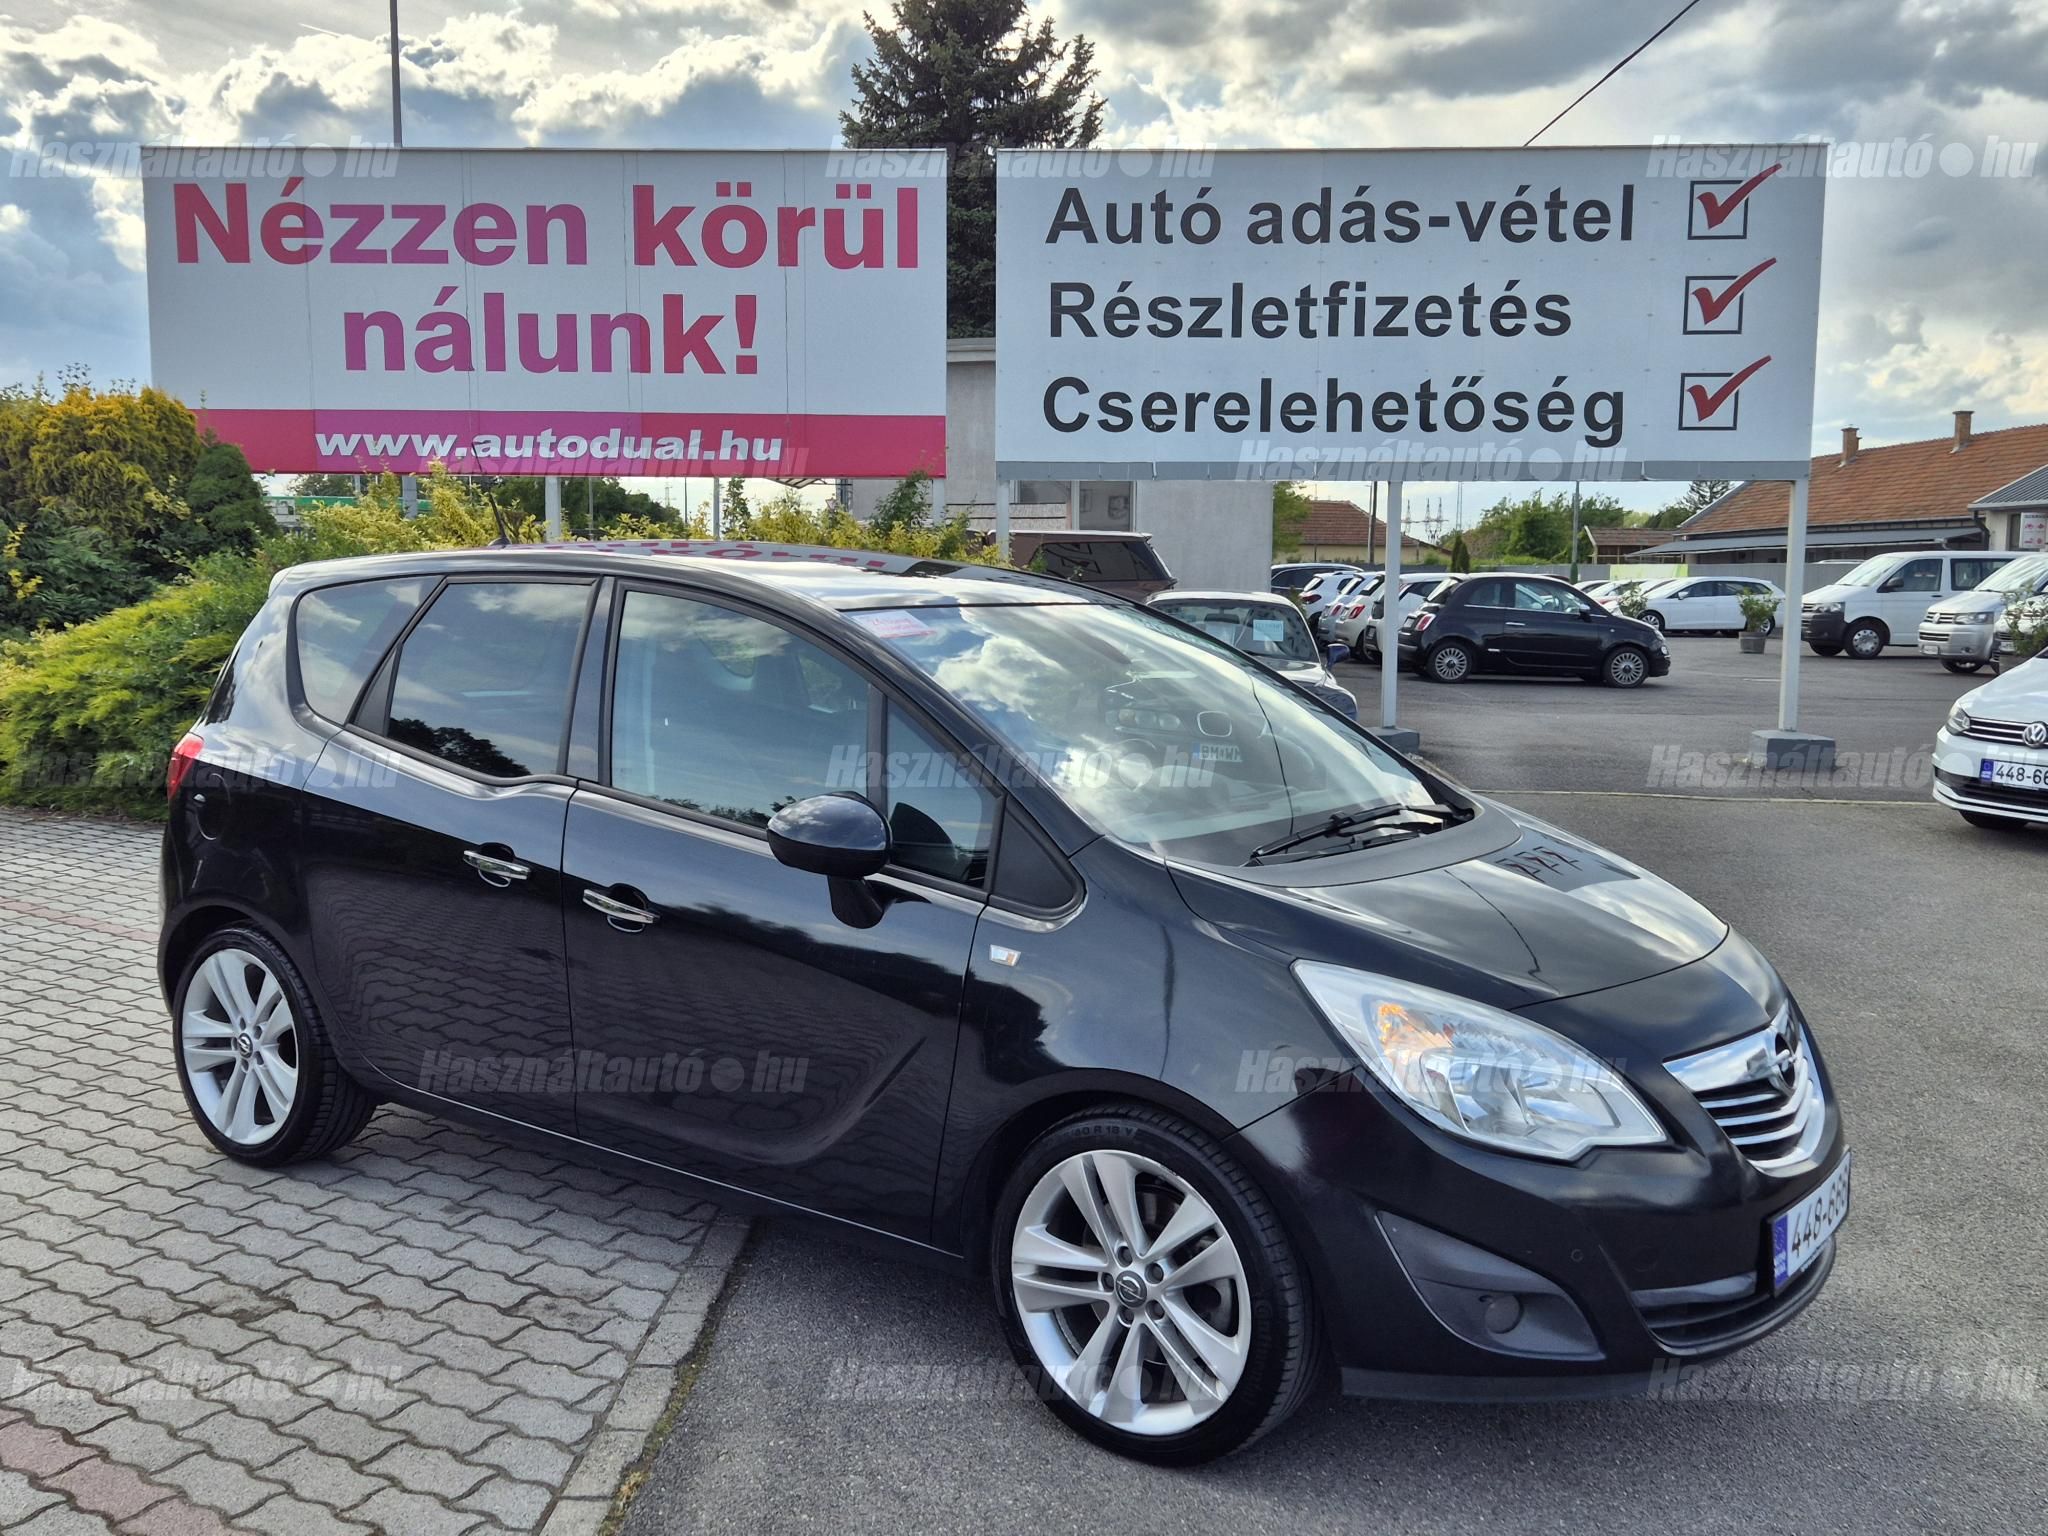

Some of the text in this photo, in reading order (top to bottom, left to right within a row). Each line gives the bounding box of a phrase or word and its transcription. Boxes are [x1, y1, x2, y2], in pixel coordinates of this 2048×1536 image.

[177, 177, 918, 269] Nézzen körül
[1045, 184, 1634, 245] Autó adás-vétel
[344, 286, 759, 375] nálunk!
[1050, 279, 1571, 339] Részletfizetés
[316, 428, 783, 462] www.autodual.hu
[1043, 375, 1624, 448] Cserelehetőség
